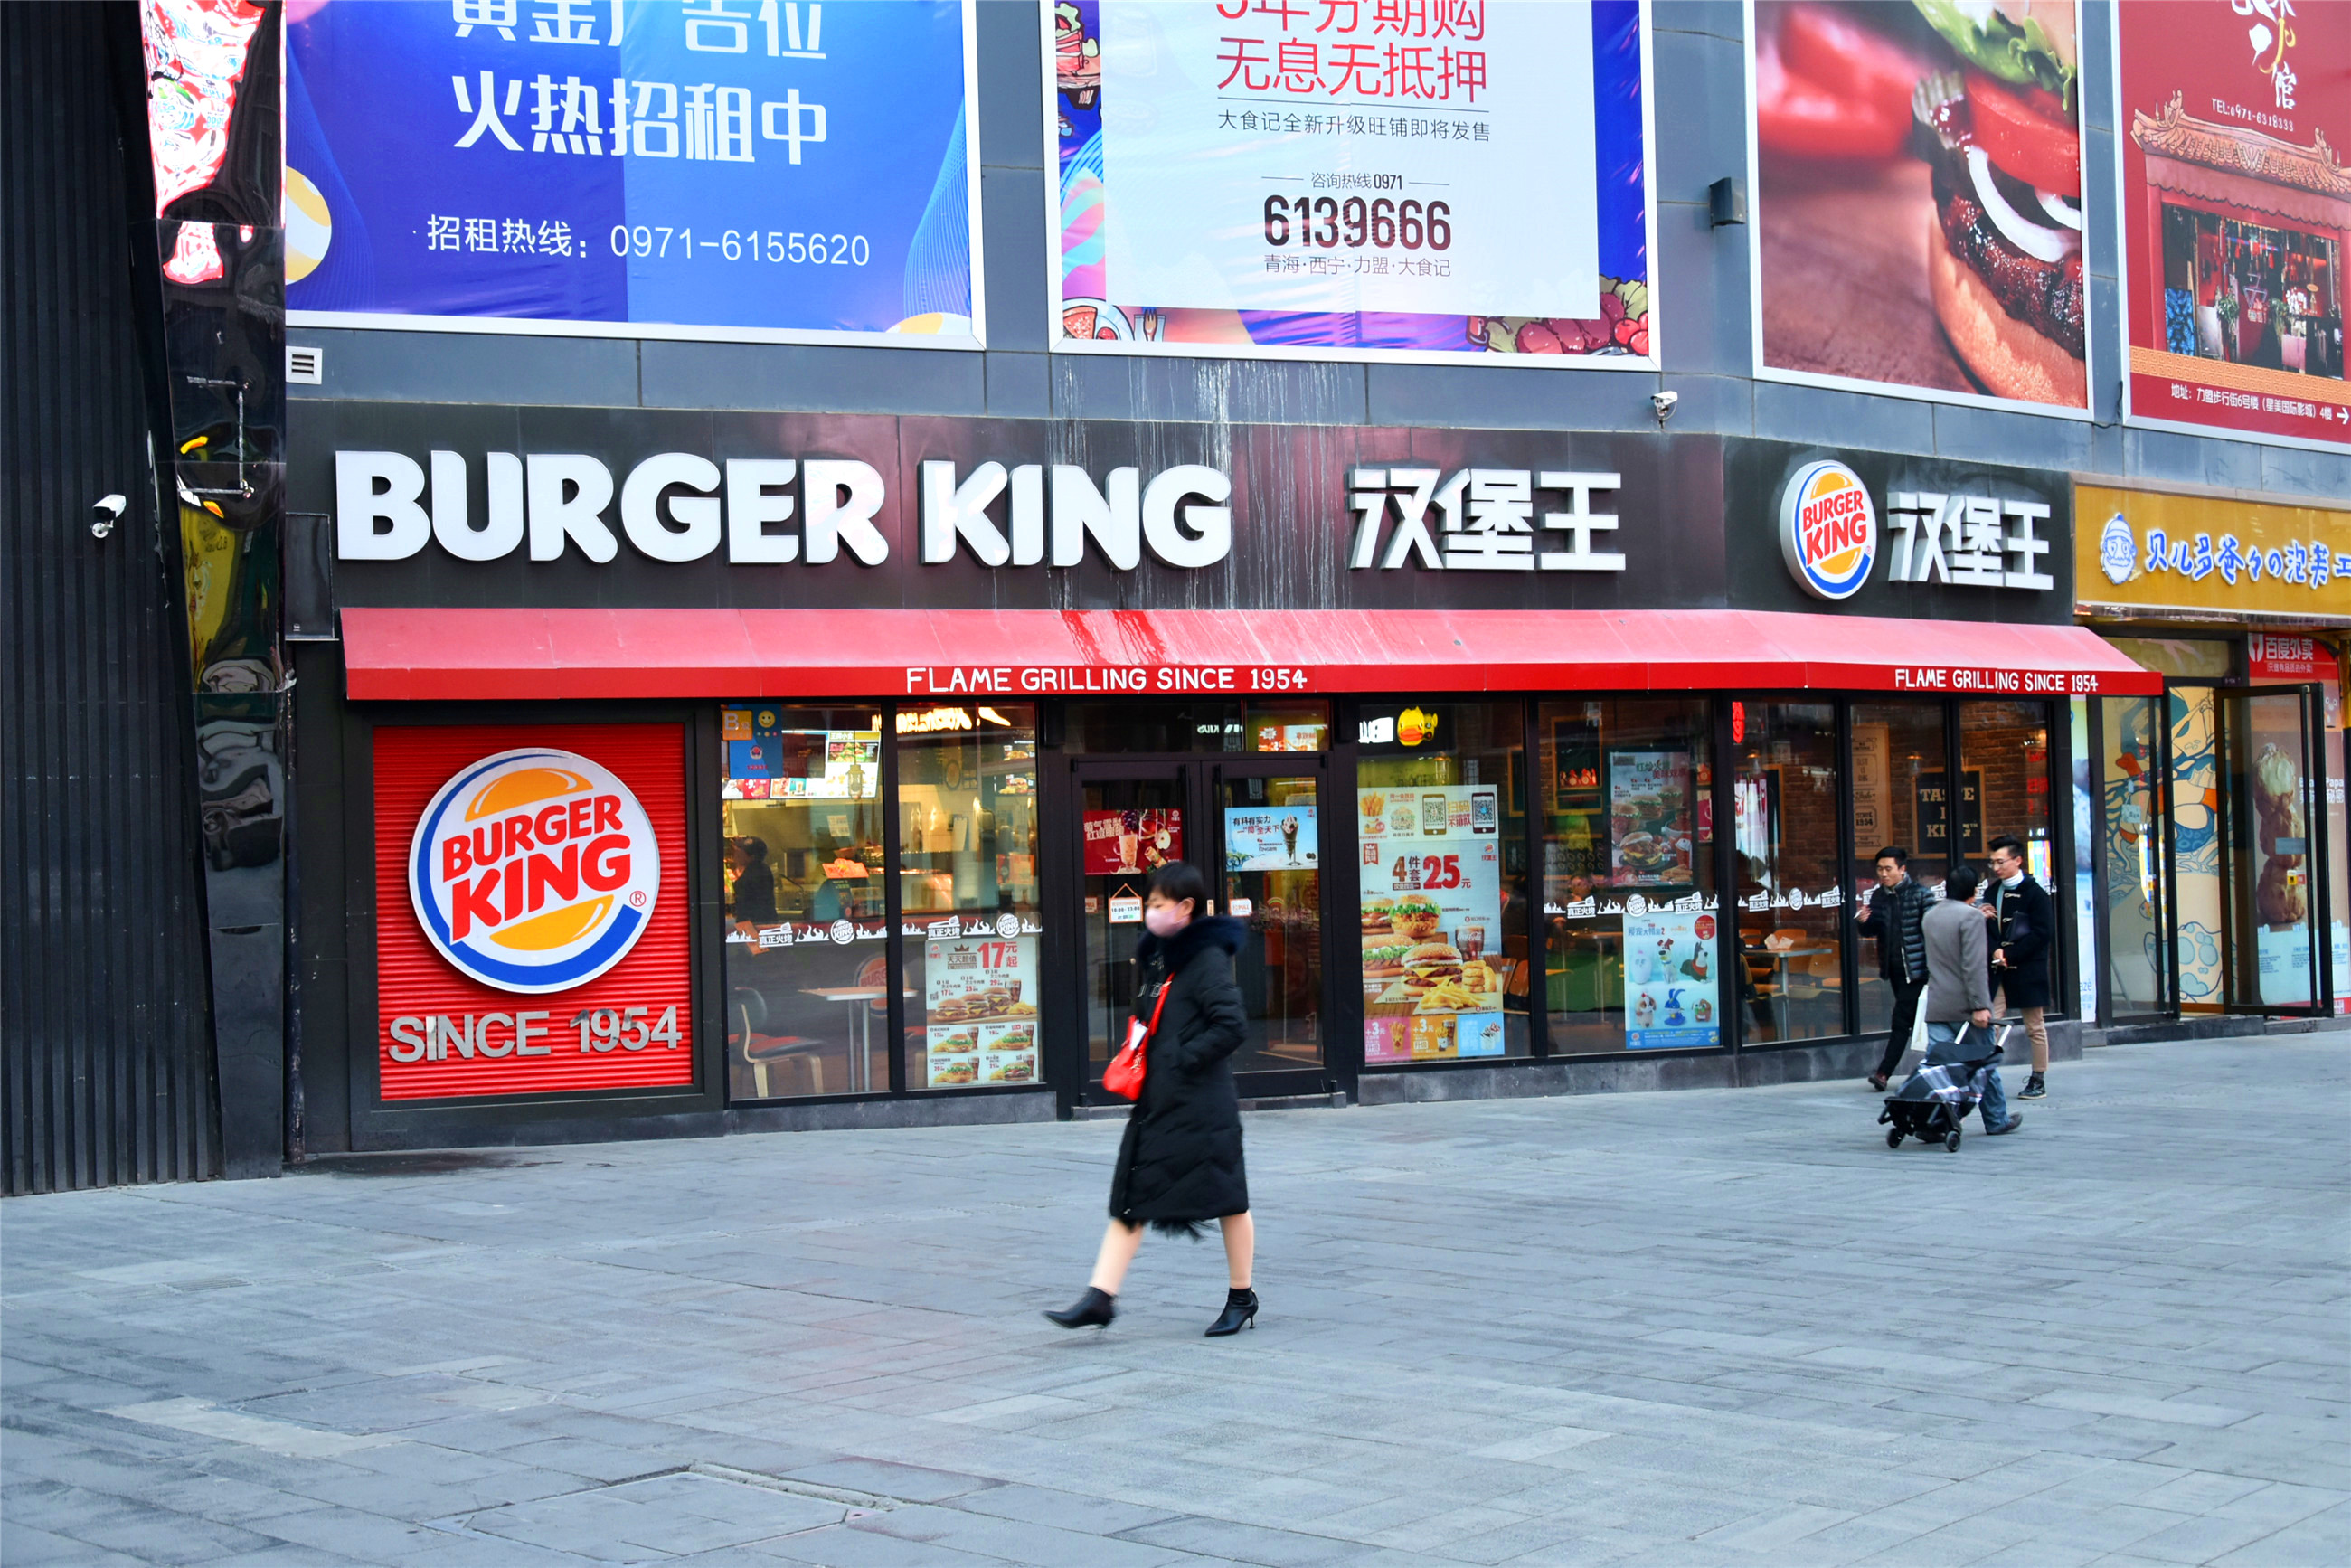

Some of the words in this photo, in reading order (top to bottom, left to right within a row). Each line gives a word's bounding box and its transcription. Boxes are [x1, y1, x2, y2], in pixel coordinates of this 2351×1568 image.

[1216, 36, 1487, 104] 无息无抵押
[452, 70, 827, 165] 火热招租中
[1218, 109, 1491, 143] 大食记全新升级旺铺即将发售
[1263, 194, 1451, 251] 6139666
[335, 449, 890, 567] BURGER
[920, 458, 1232, 571] KING
[1349, 467, 1628, 572] 汉堡王
[1802, 489, 1865, 534] BURGER
[1805, 511, 1867, 566] KING
[1887, 490, 2054, 591] 汉堡王
[2266, 637, 2313, 660] 百度外卖
[906, 667, 1012, 694] FLAME
[1020, 667, 1147, 692] GRILLING
[1157, 666, 1236, 691] SINCE
[1250, 667, 1308, 691] 1954
[1894, 668, 1947, 688] FLAME
[1951, 669, 2020, 691] GRILLING
[2024, 673, 2065, 692] SINCE
[2071, 674, 2099, 692] 1954
[443, 793, 624, 883] BURGER
[452, 833, 632, 943] KING
[1393, 855, 1407, 882] 4
[1423, 854, 1461, 890] 25
[1461, 878, 1472, 890] 元
[977, 941, 1006, 969] 17
[387, 1010, 552, 1063] SINCE
[569, 1005, 683, 1053] 1954
